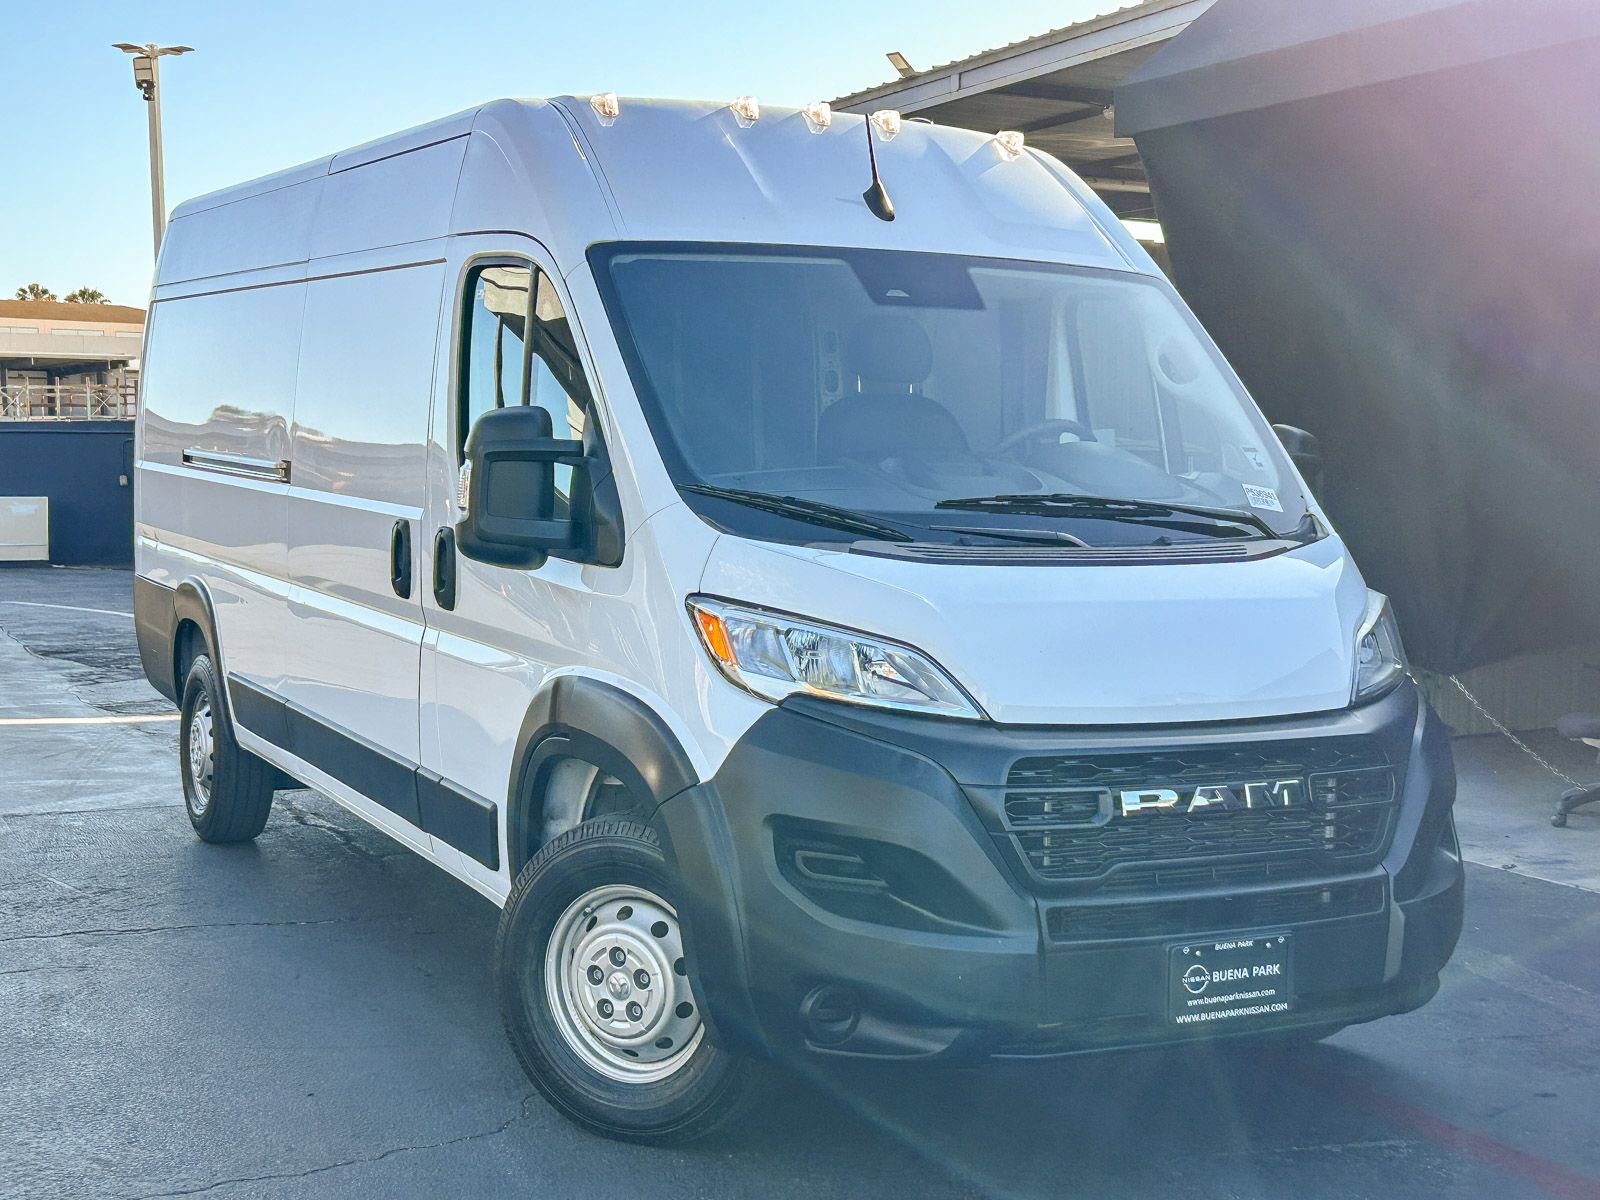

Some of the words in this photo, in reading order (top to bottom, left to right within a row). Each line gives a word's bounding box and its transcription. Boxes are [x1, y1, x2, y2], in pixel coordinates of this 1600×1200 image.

[1120, 778, 1306, 817] RAM
[1214, 942, 1236, 951] BUENA
[1237, 940, 1254, 948] PARK
[1182, 974, 1211, 984] NISSAN
[1212, 967, 1249, 982] BUENA
[1252, 963, 1281, 977] PARK
[1186, 988, 1276, 1007] www.buenaparknissan.com
[1175, 1002, 1288, 1024] WWW.BUENAPARKNISSAN.COM
